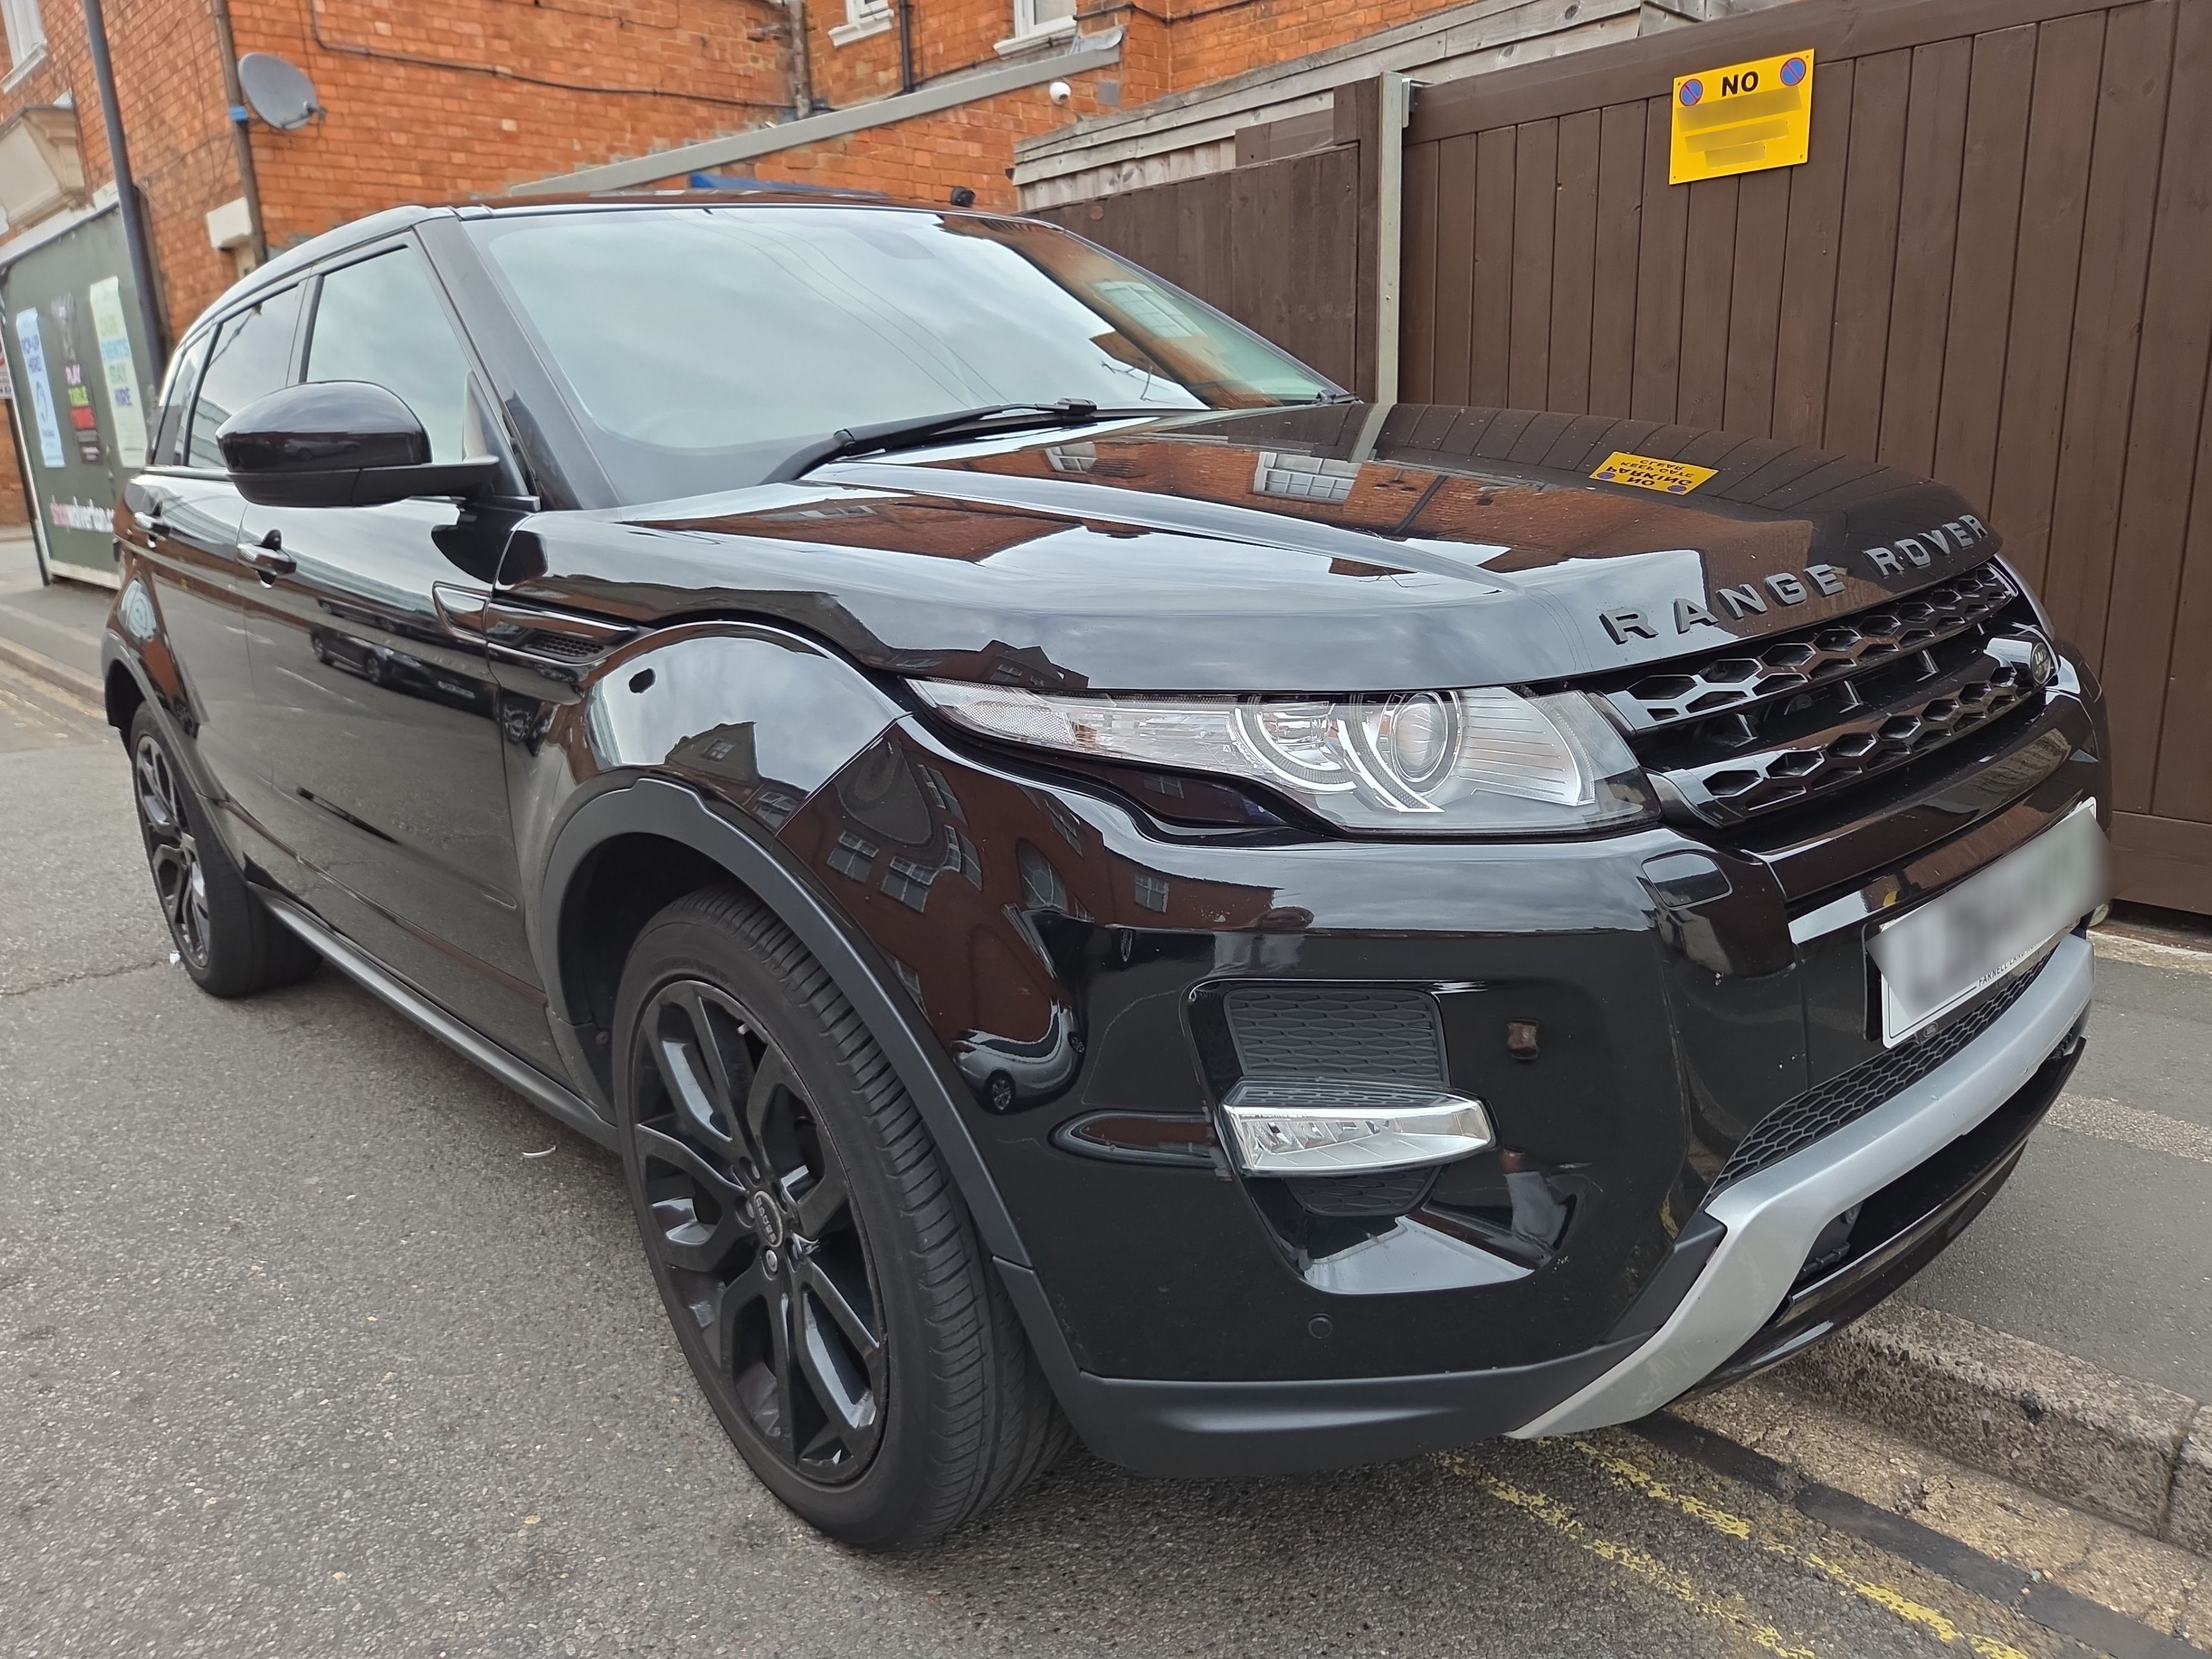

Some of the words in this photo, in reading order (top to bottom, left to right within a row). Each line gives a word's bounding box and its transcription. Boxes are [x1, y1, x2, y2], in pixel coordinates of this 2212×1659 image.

[1722, 71, 1759, 97] NO
[1598, 564, 1846, 645] RANGE
[1863, 514, 1988, 577] ROVER
